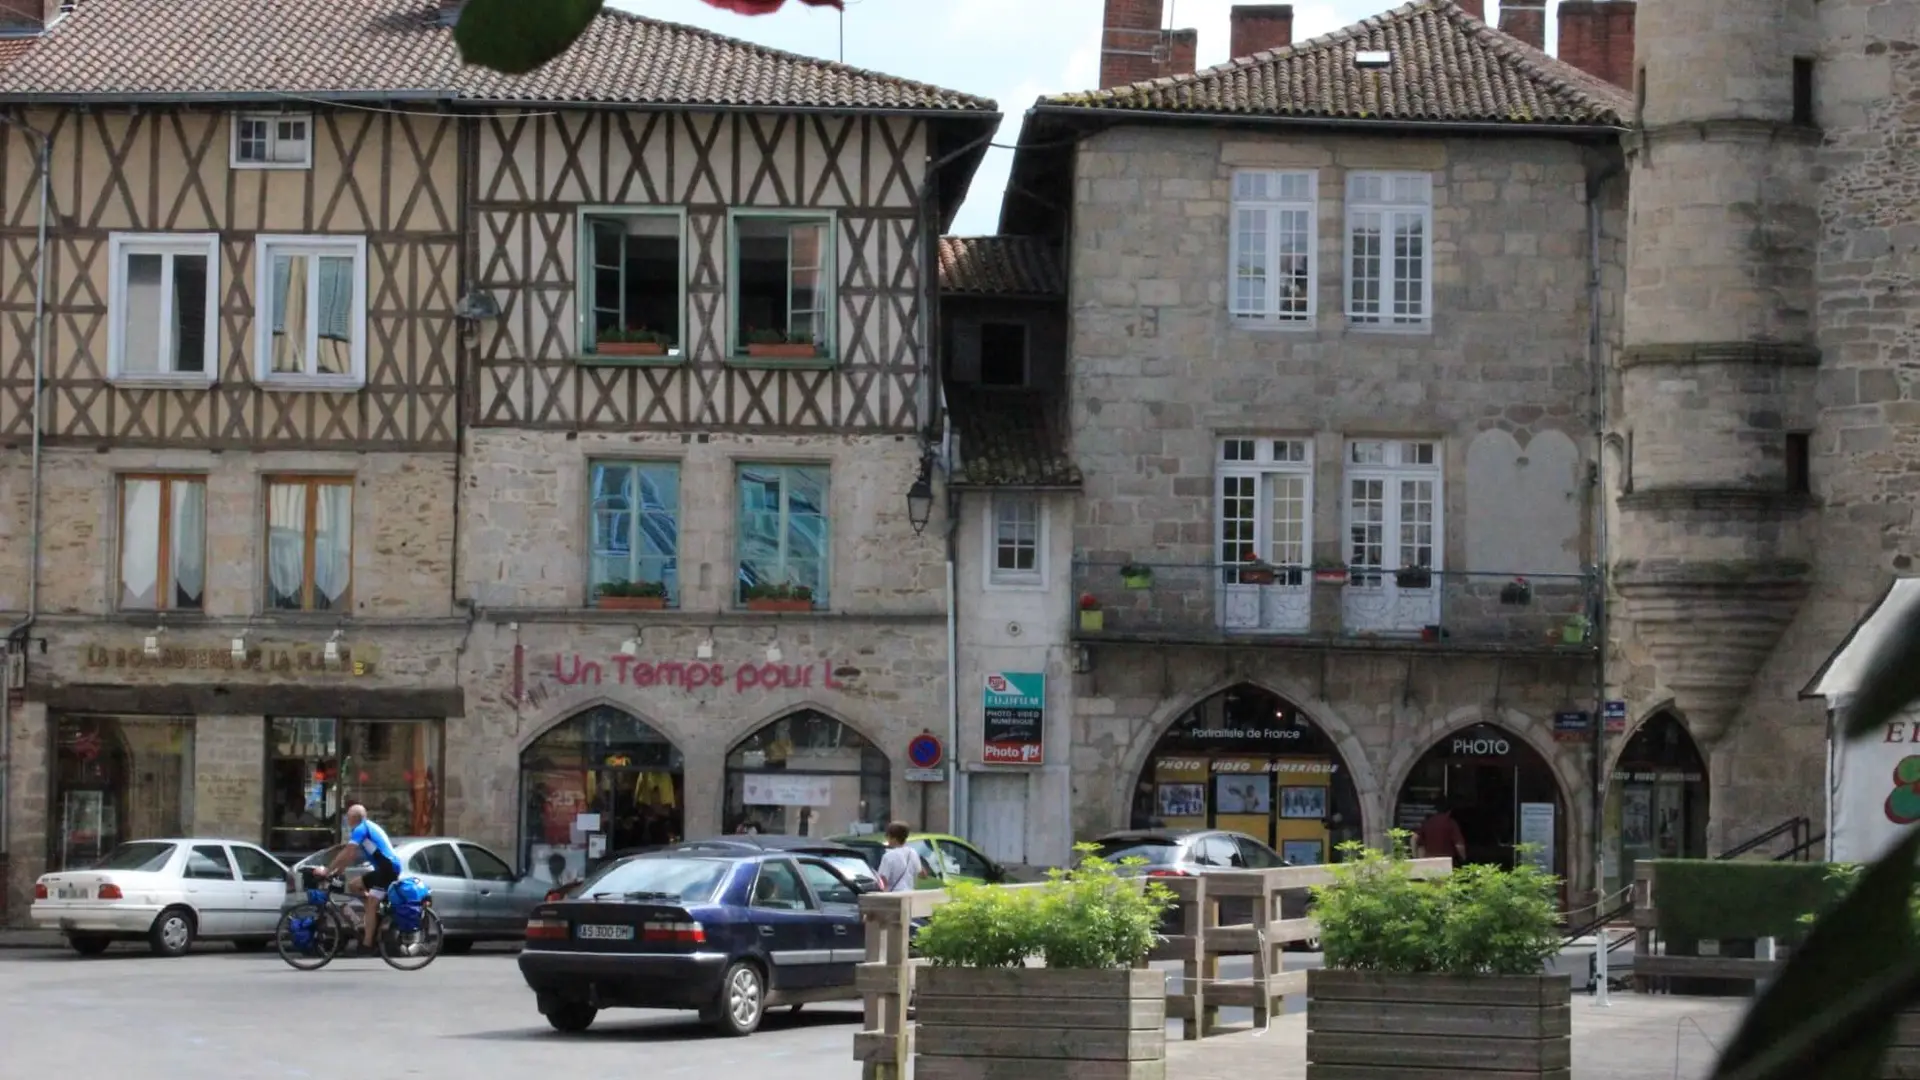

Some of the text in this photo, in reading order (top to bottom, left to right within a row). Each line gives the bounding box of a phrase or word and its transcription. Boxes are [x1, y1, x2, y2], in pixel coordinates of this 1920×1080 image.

[555, 653, 602, 685] Un
[611, 655, 725, 692] Temps
[735, 662, 814, 694] pour
[987, 695, 1039, 705] FUJIFILM
[1192, 728, 1300, 739] Portraitiste de France
[985, 744, 1020, 758] Photo
[1453, 739, 1509, 755] PHOTO
[1156, 761, 1201, 771] PHOTO
